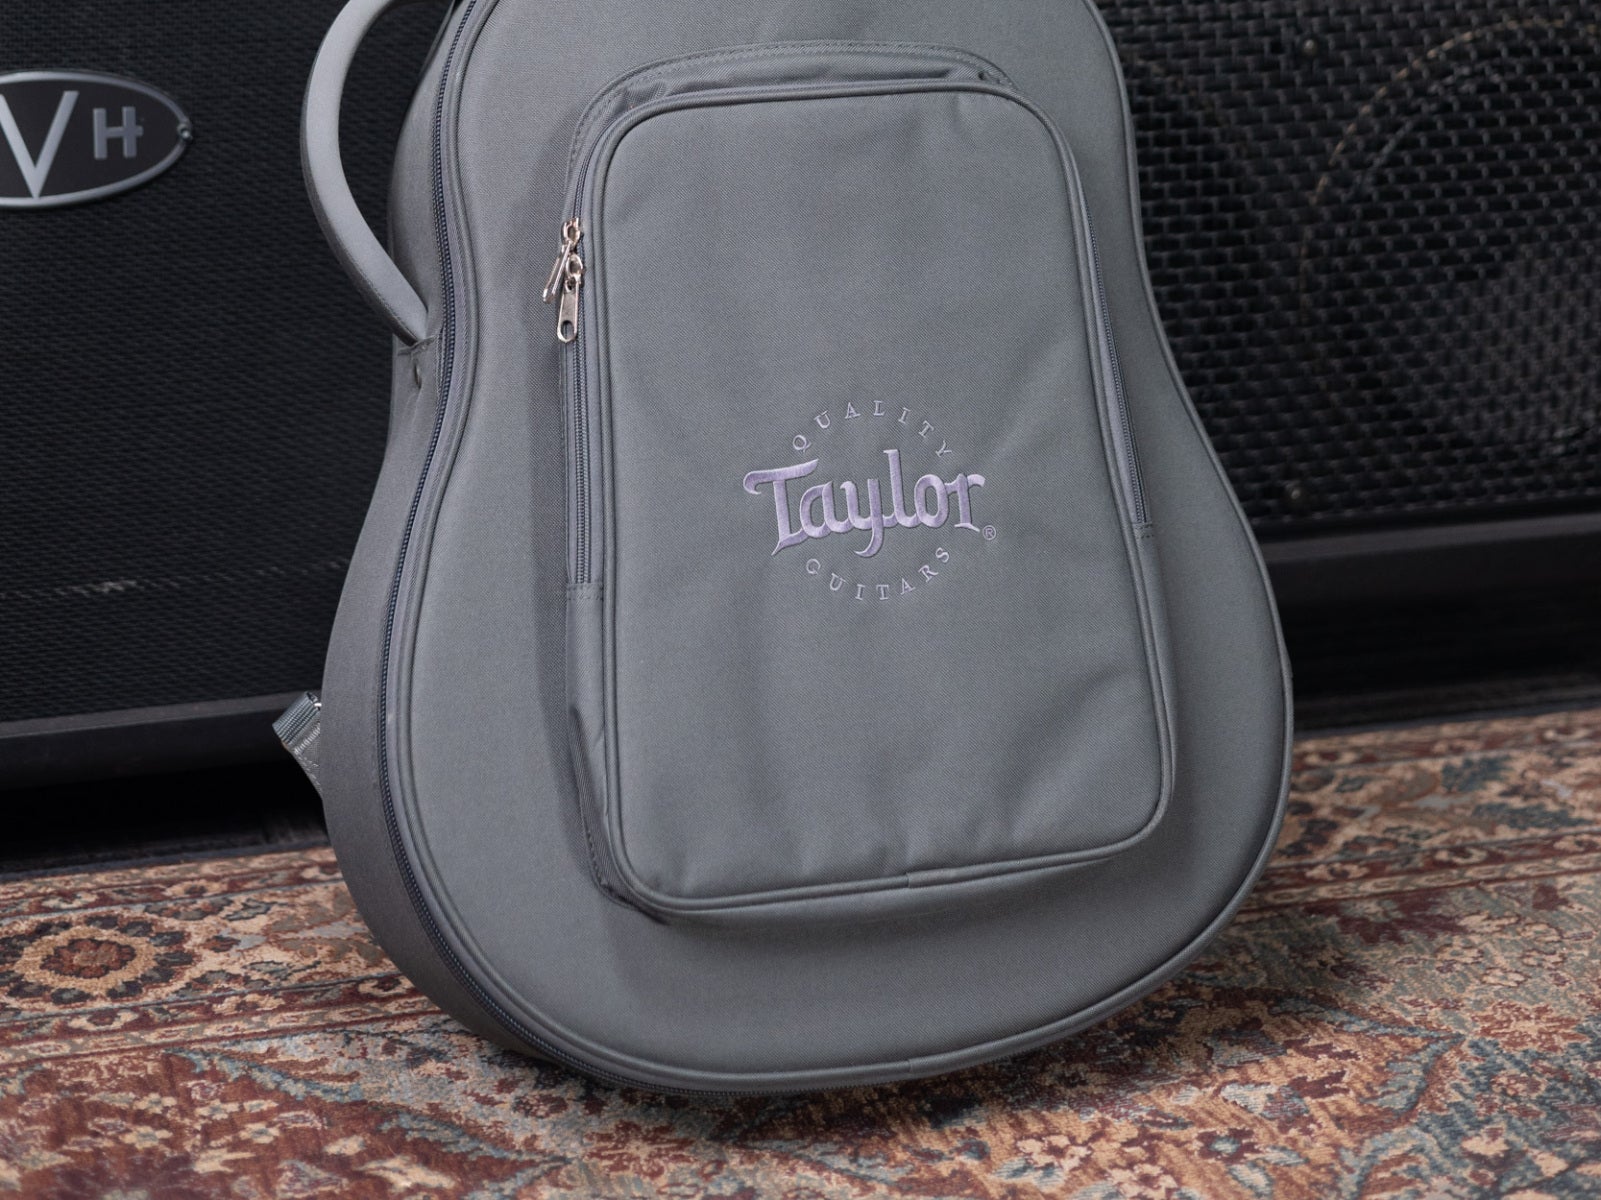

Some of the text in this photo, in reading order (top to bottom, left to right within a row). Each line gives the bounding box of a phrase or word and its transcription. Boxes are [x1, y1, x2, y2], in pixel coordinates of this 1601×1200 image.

[792, 400, 952, 452] QUALITY
[743, 449, 986, 558] Taylor
[805, 546, 950, 601] GUITARS
